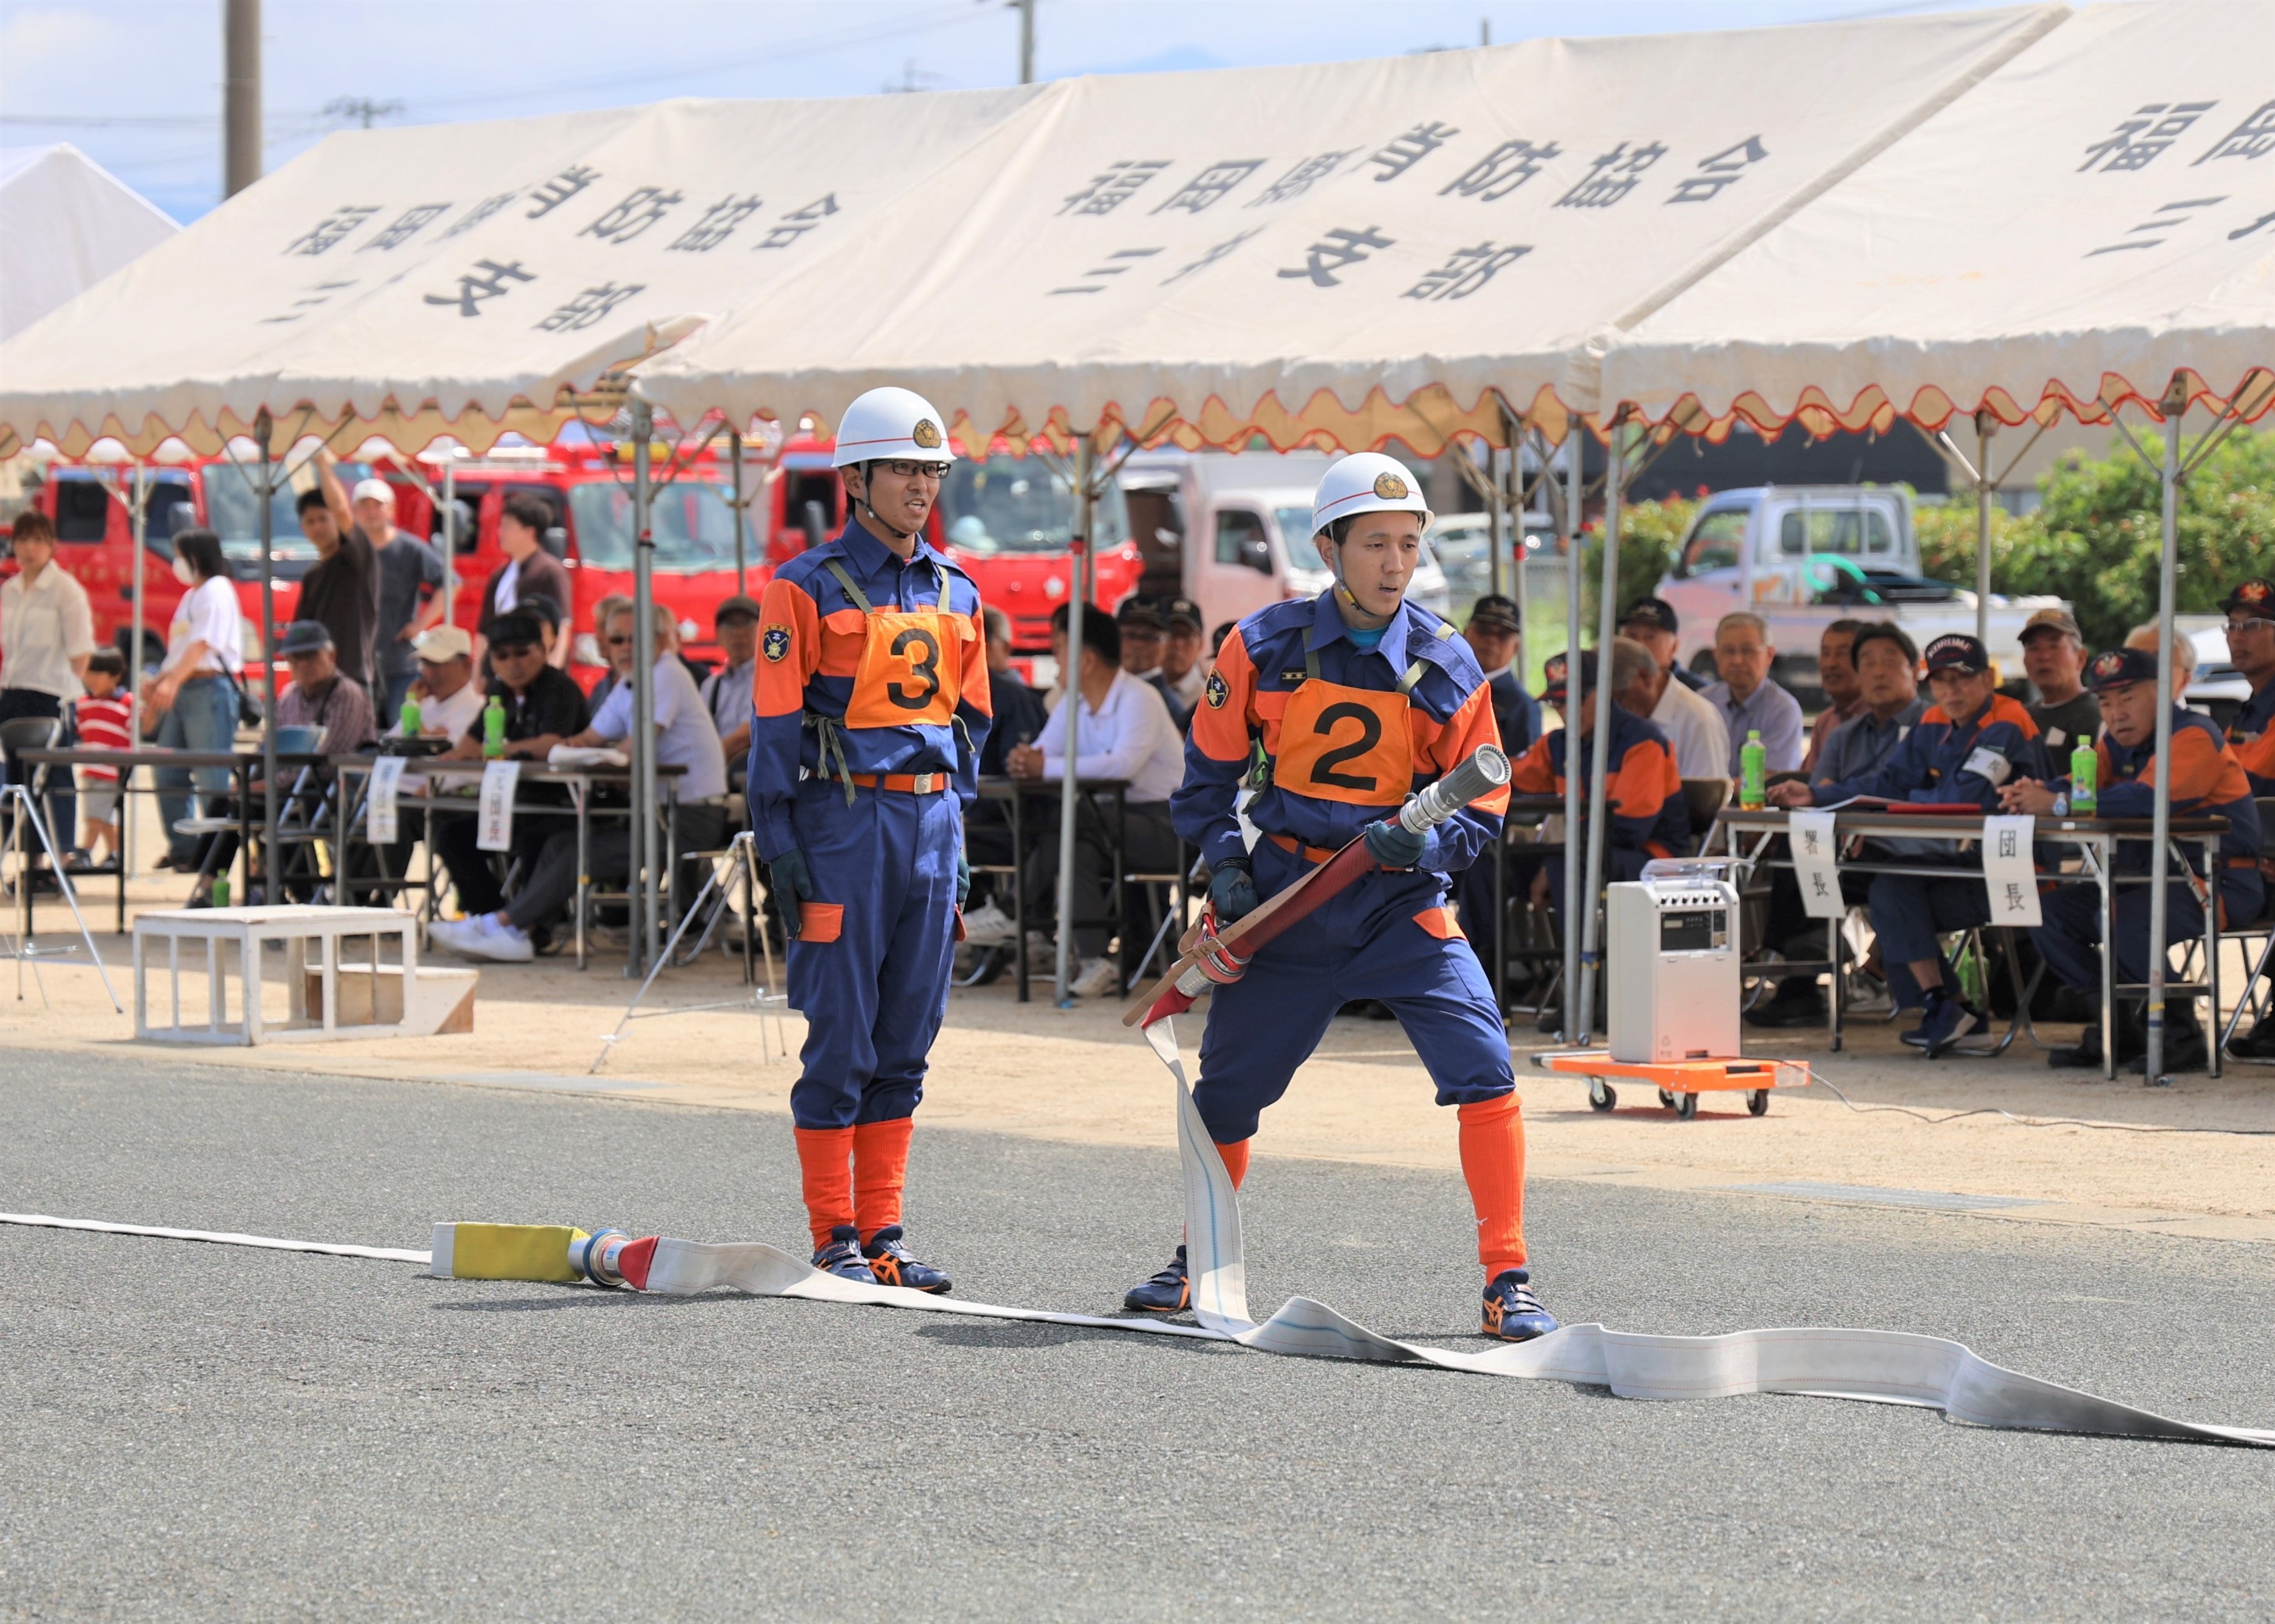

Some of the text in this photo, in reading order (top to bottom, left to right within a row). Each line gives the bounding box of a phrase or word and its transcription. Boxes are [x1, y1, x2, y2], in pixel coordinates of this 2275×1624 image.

[887, 628, 940, 710] 3
[1309, 701, 1382, 791] 2
[1999, 829, 2025, 911] 団長
